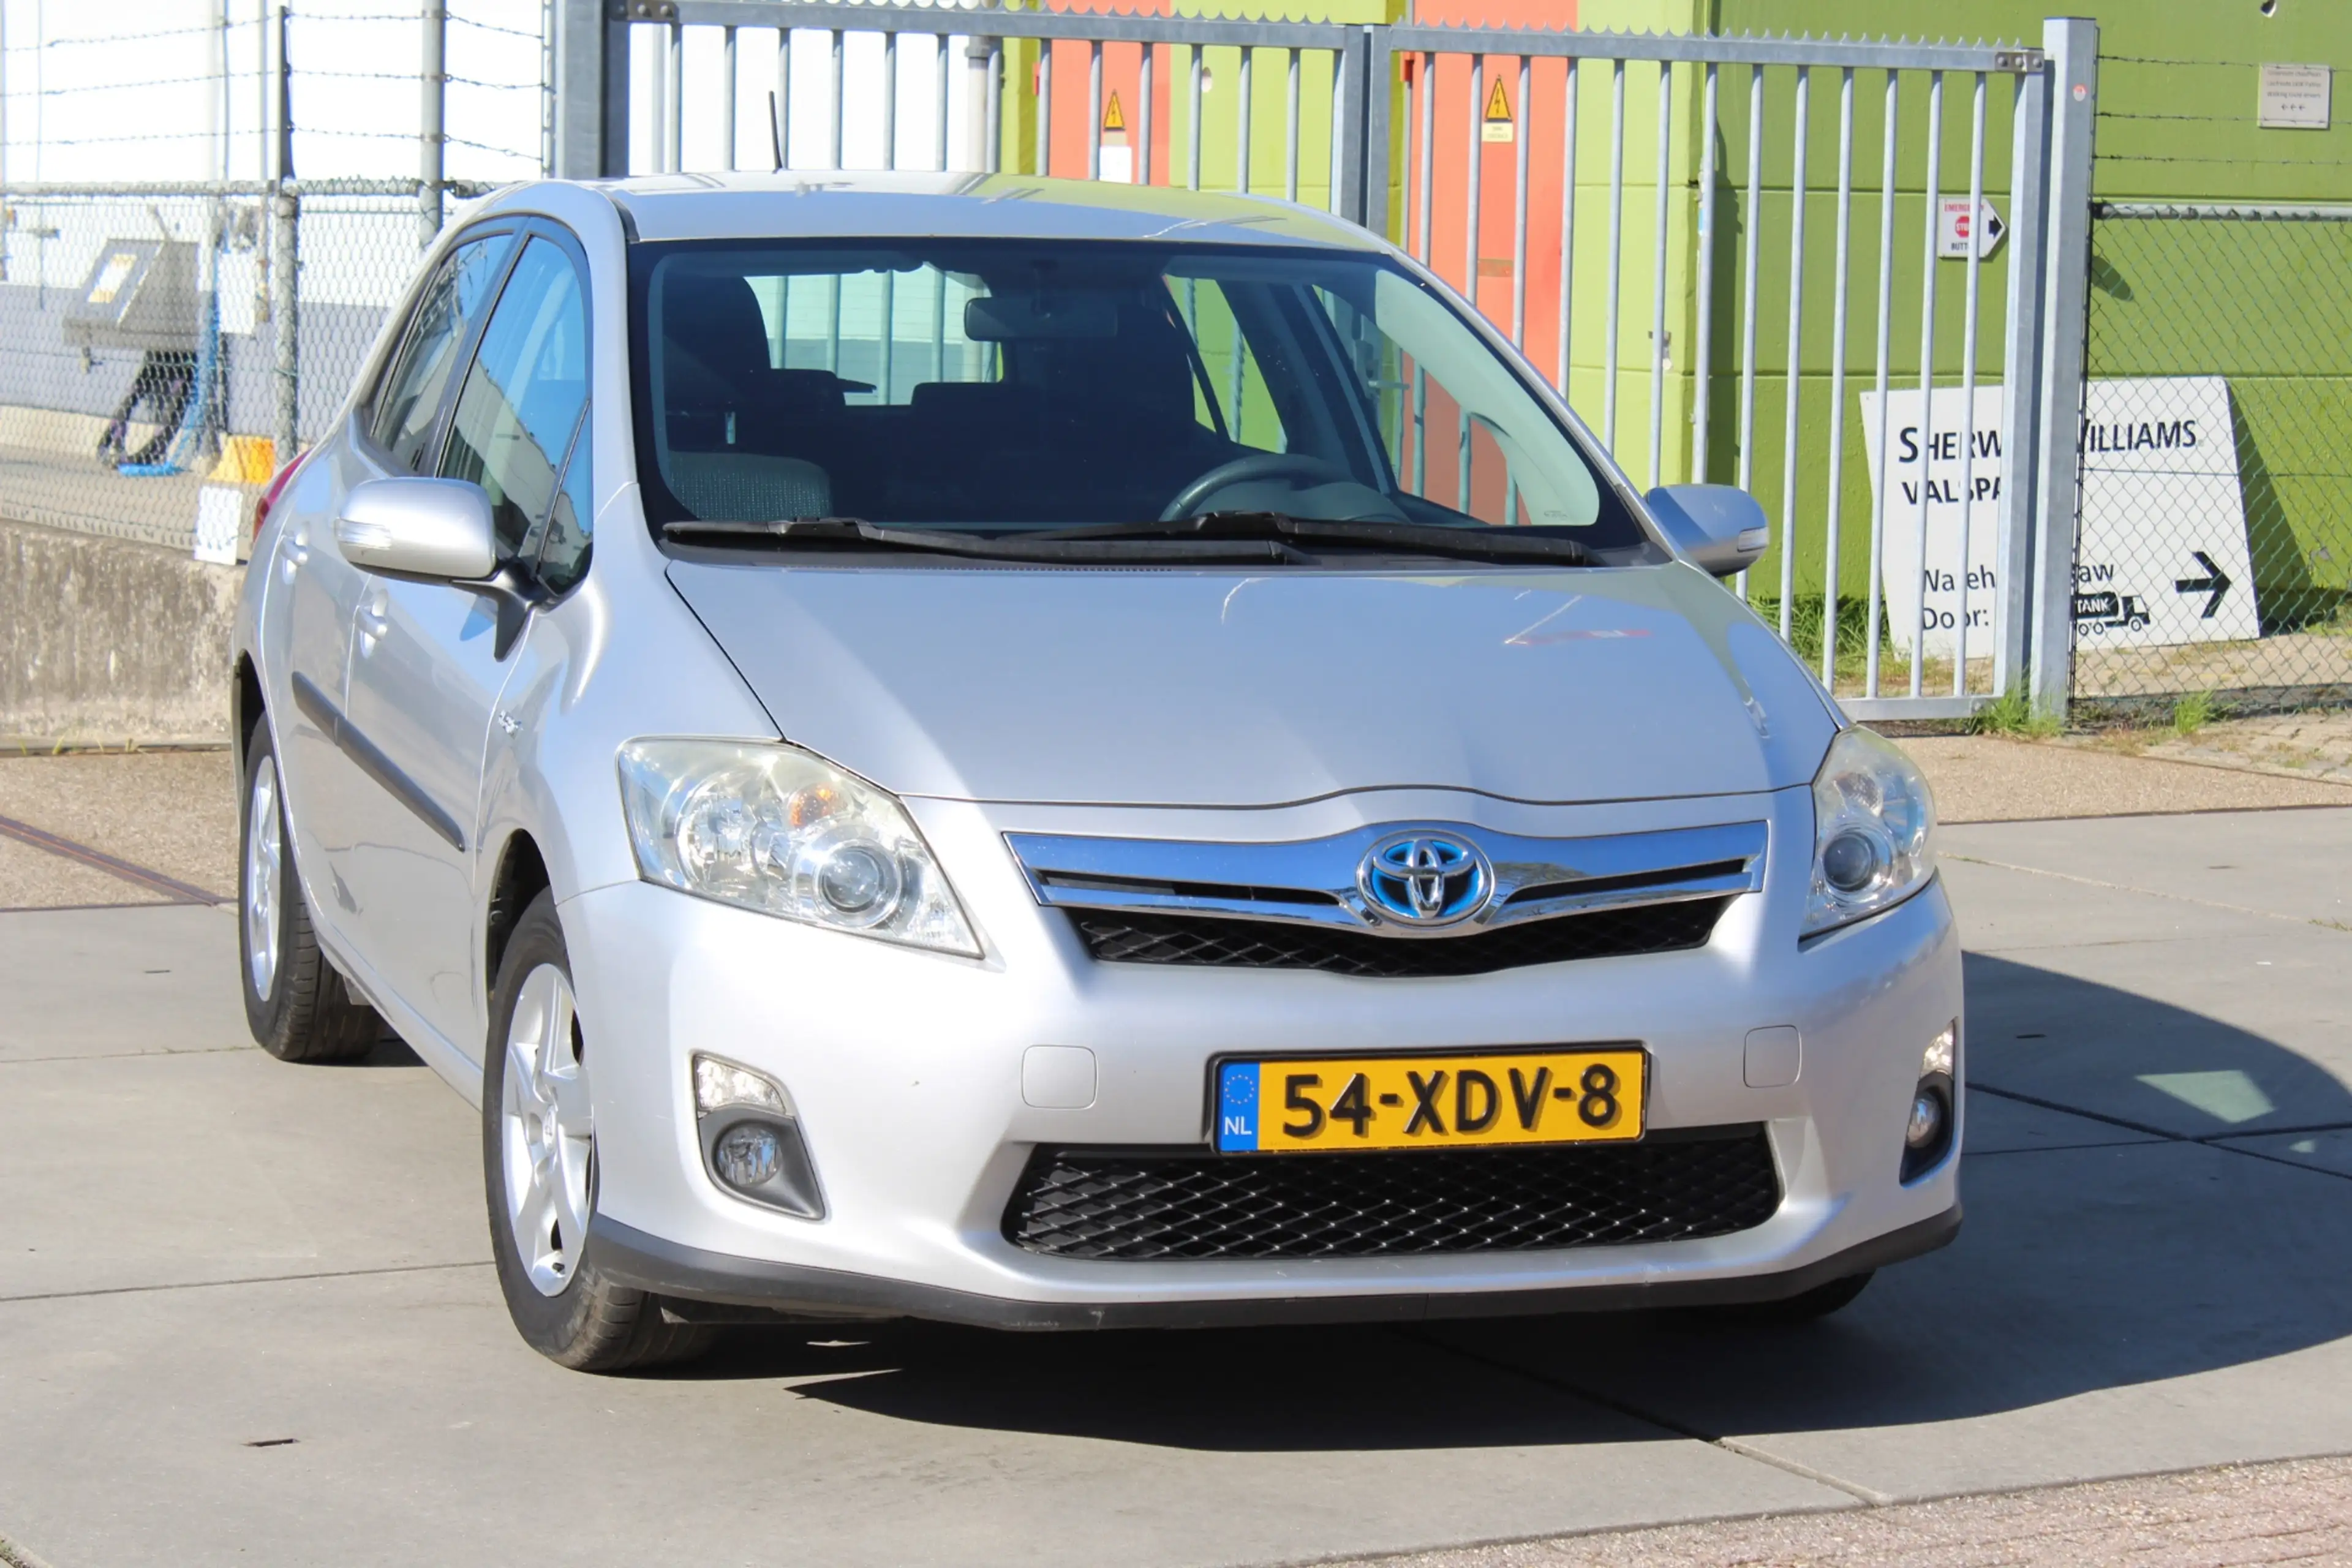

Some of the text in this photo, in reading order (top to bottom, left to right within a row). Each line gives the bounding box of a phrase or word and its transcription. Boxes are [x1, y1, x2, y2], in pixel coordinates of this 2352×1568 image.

[1951, 242, 1969, 251] BUTT
[2082, 419, 2196, 453] ILLIAMS
[1901, 476, 2000, 505] VALPA
[2076, 597, 2111, 614] TANK
[1282, 1063, 1618, 1137] 54-XDV-8
[1223, 1115, 1253, 1137] NL
